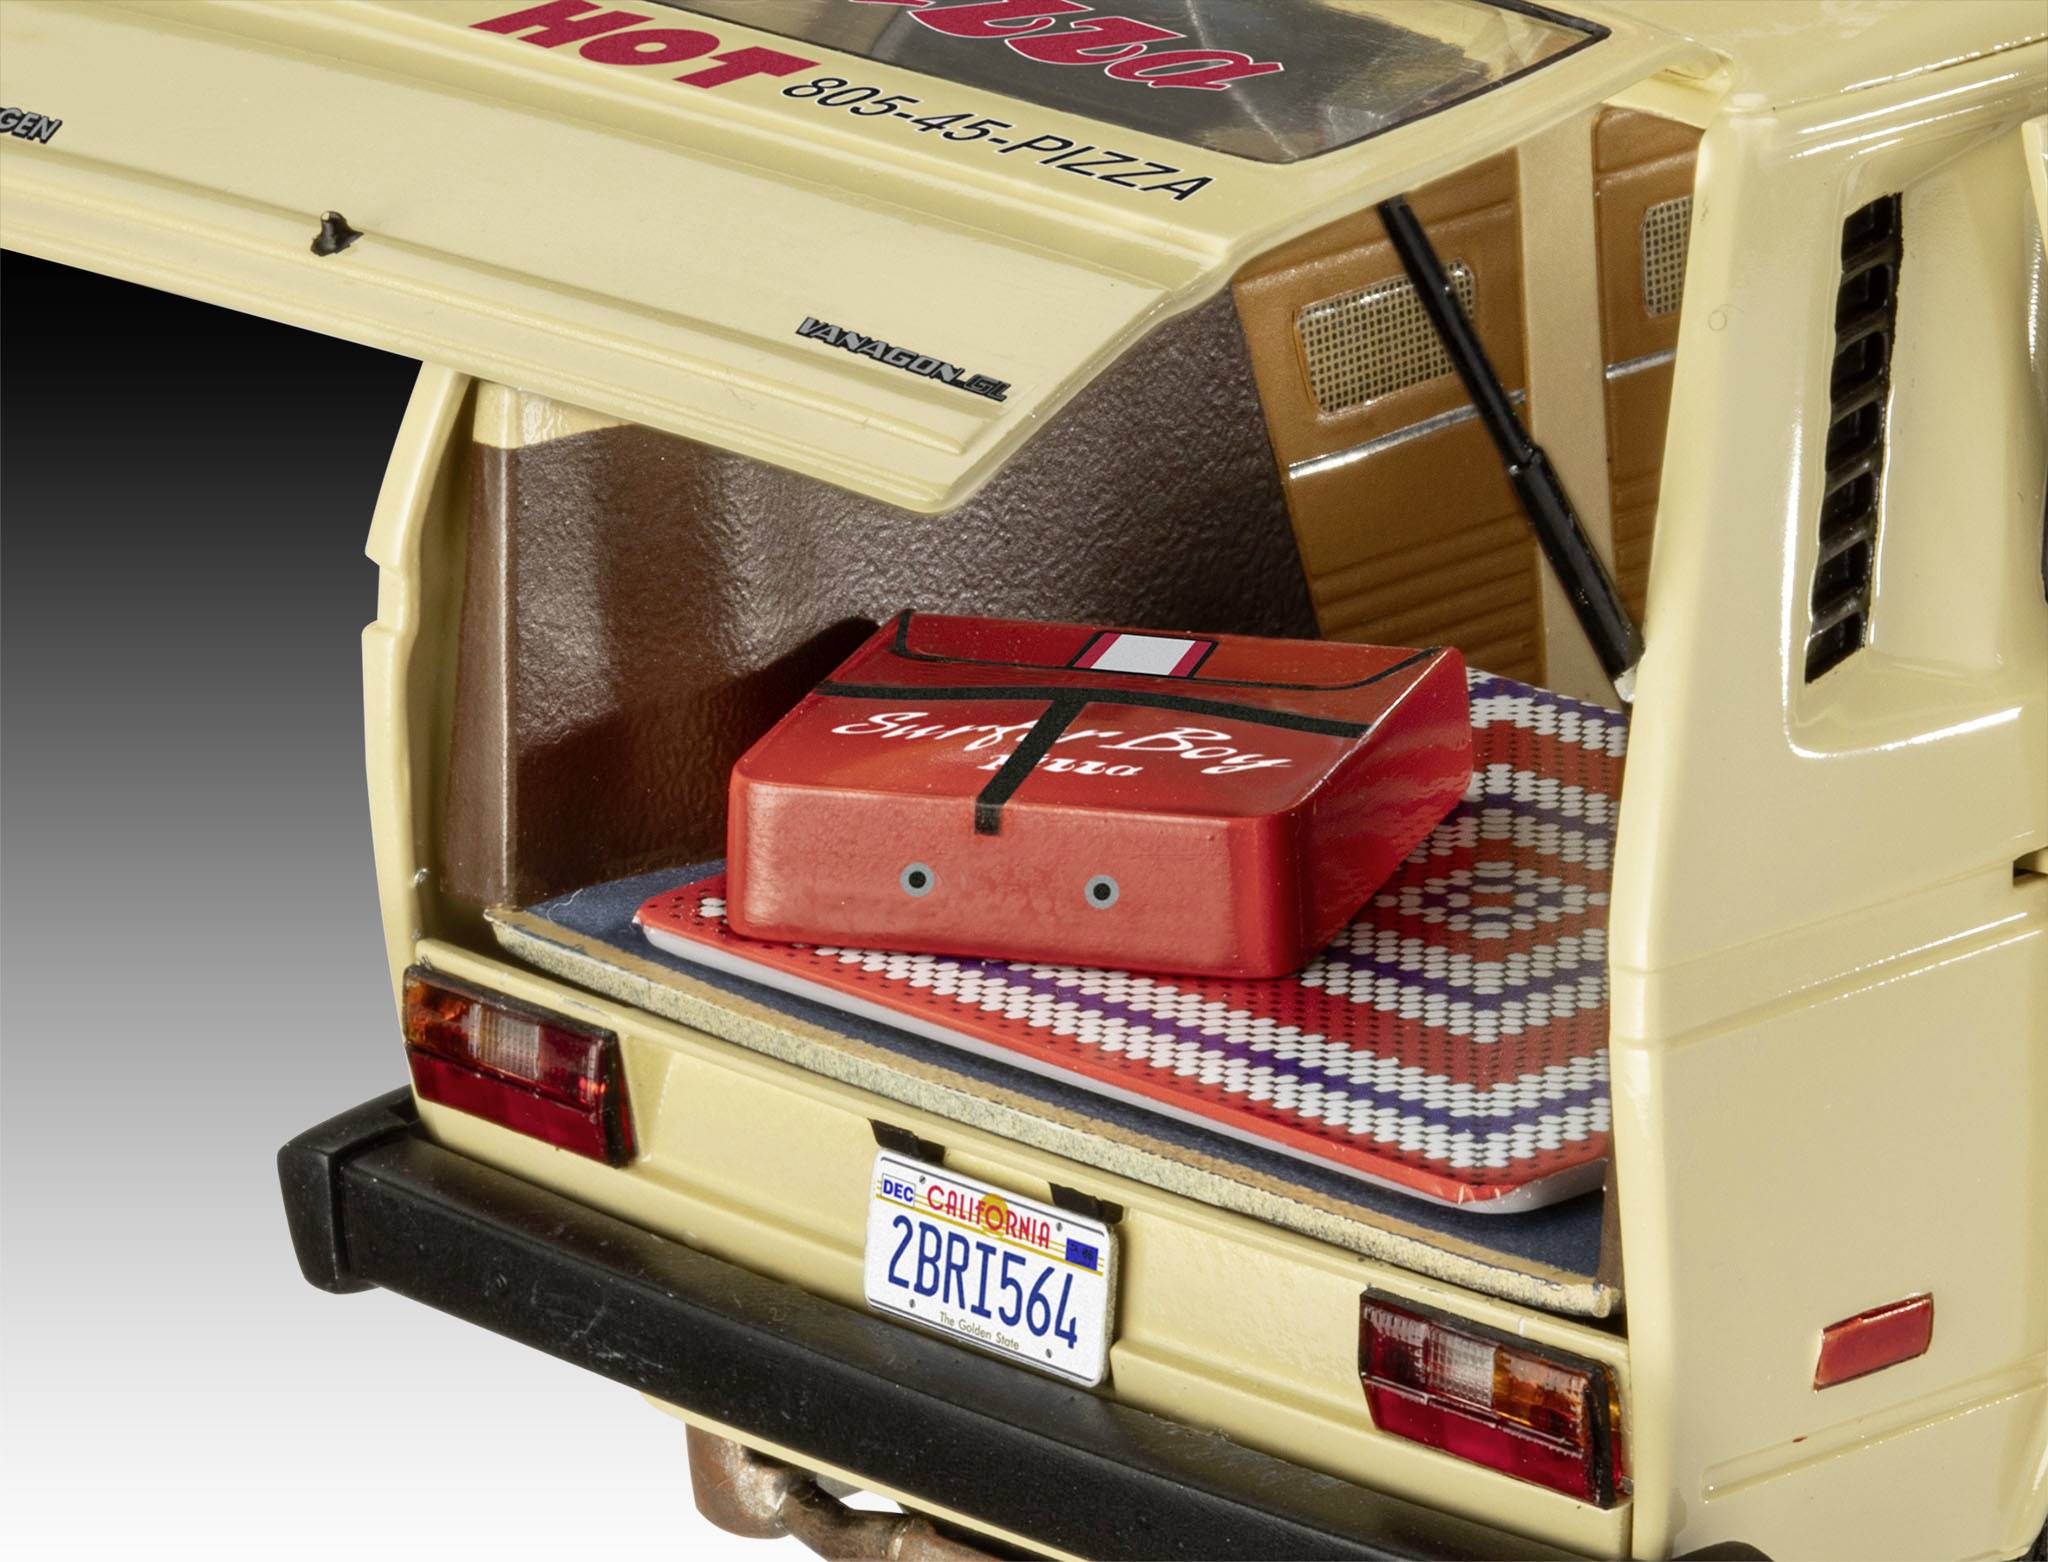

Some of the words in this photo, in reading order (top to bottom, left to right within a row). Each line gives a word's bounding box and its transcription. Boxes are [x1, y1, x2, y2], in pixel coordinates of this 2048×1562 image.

[849, 0, 1285, 91] zza
[0, 107, 63, 144] GEN
[471, 0, 821, 89] HOT
[780, 75, 1214, 201] 805-45-PIZZA
[796, 316, 965, 384] VANAGON
[962, 373, 1011, 402] GL
[831, 711, 1124, 752] Surfr
[1097, 726, 1294, 775] Boy
[882, 1178, 914, 1203] DEC
[926, 1185, 1051, 1249] CALIFORNIA
[887, 1214, 1078, 1350] 2BRI564
[940, 1311, 956, 1328] The
[957, 1318, 993, 1341] Golden
[995, 1332, 1021, 1351] State
